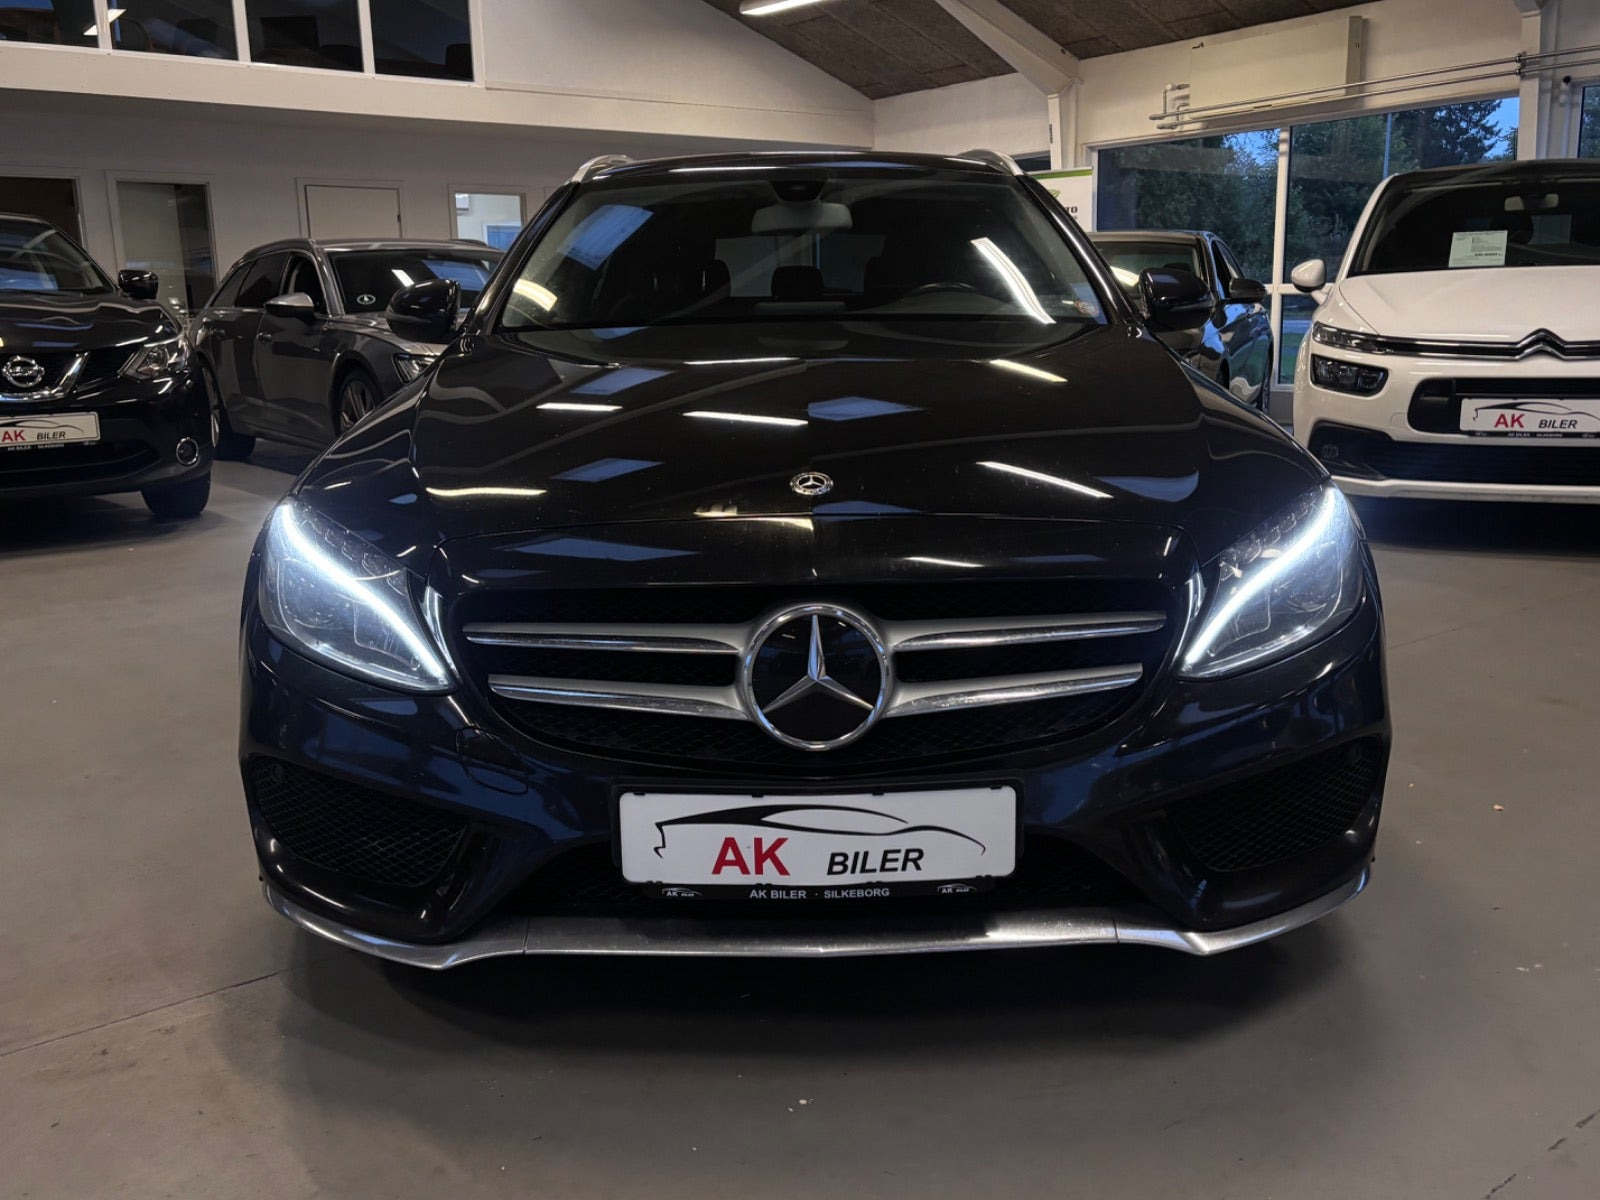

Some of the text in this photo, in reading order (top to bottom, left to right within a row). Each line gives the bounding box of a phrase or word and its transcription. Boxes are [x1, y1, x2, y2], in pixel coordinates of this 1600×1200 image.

[1494, 413, 1578, 429] AK BILER
[2, 429, 66, 442] AK BILER
[711, 836, 924, 876] AK BILER
[749, 888, 890, 899] AK BILER SILKEBORG
